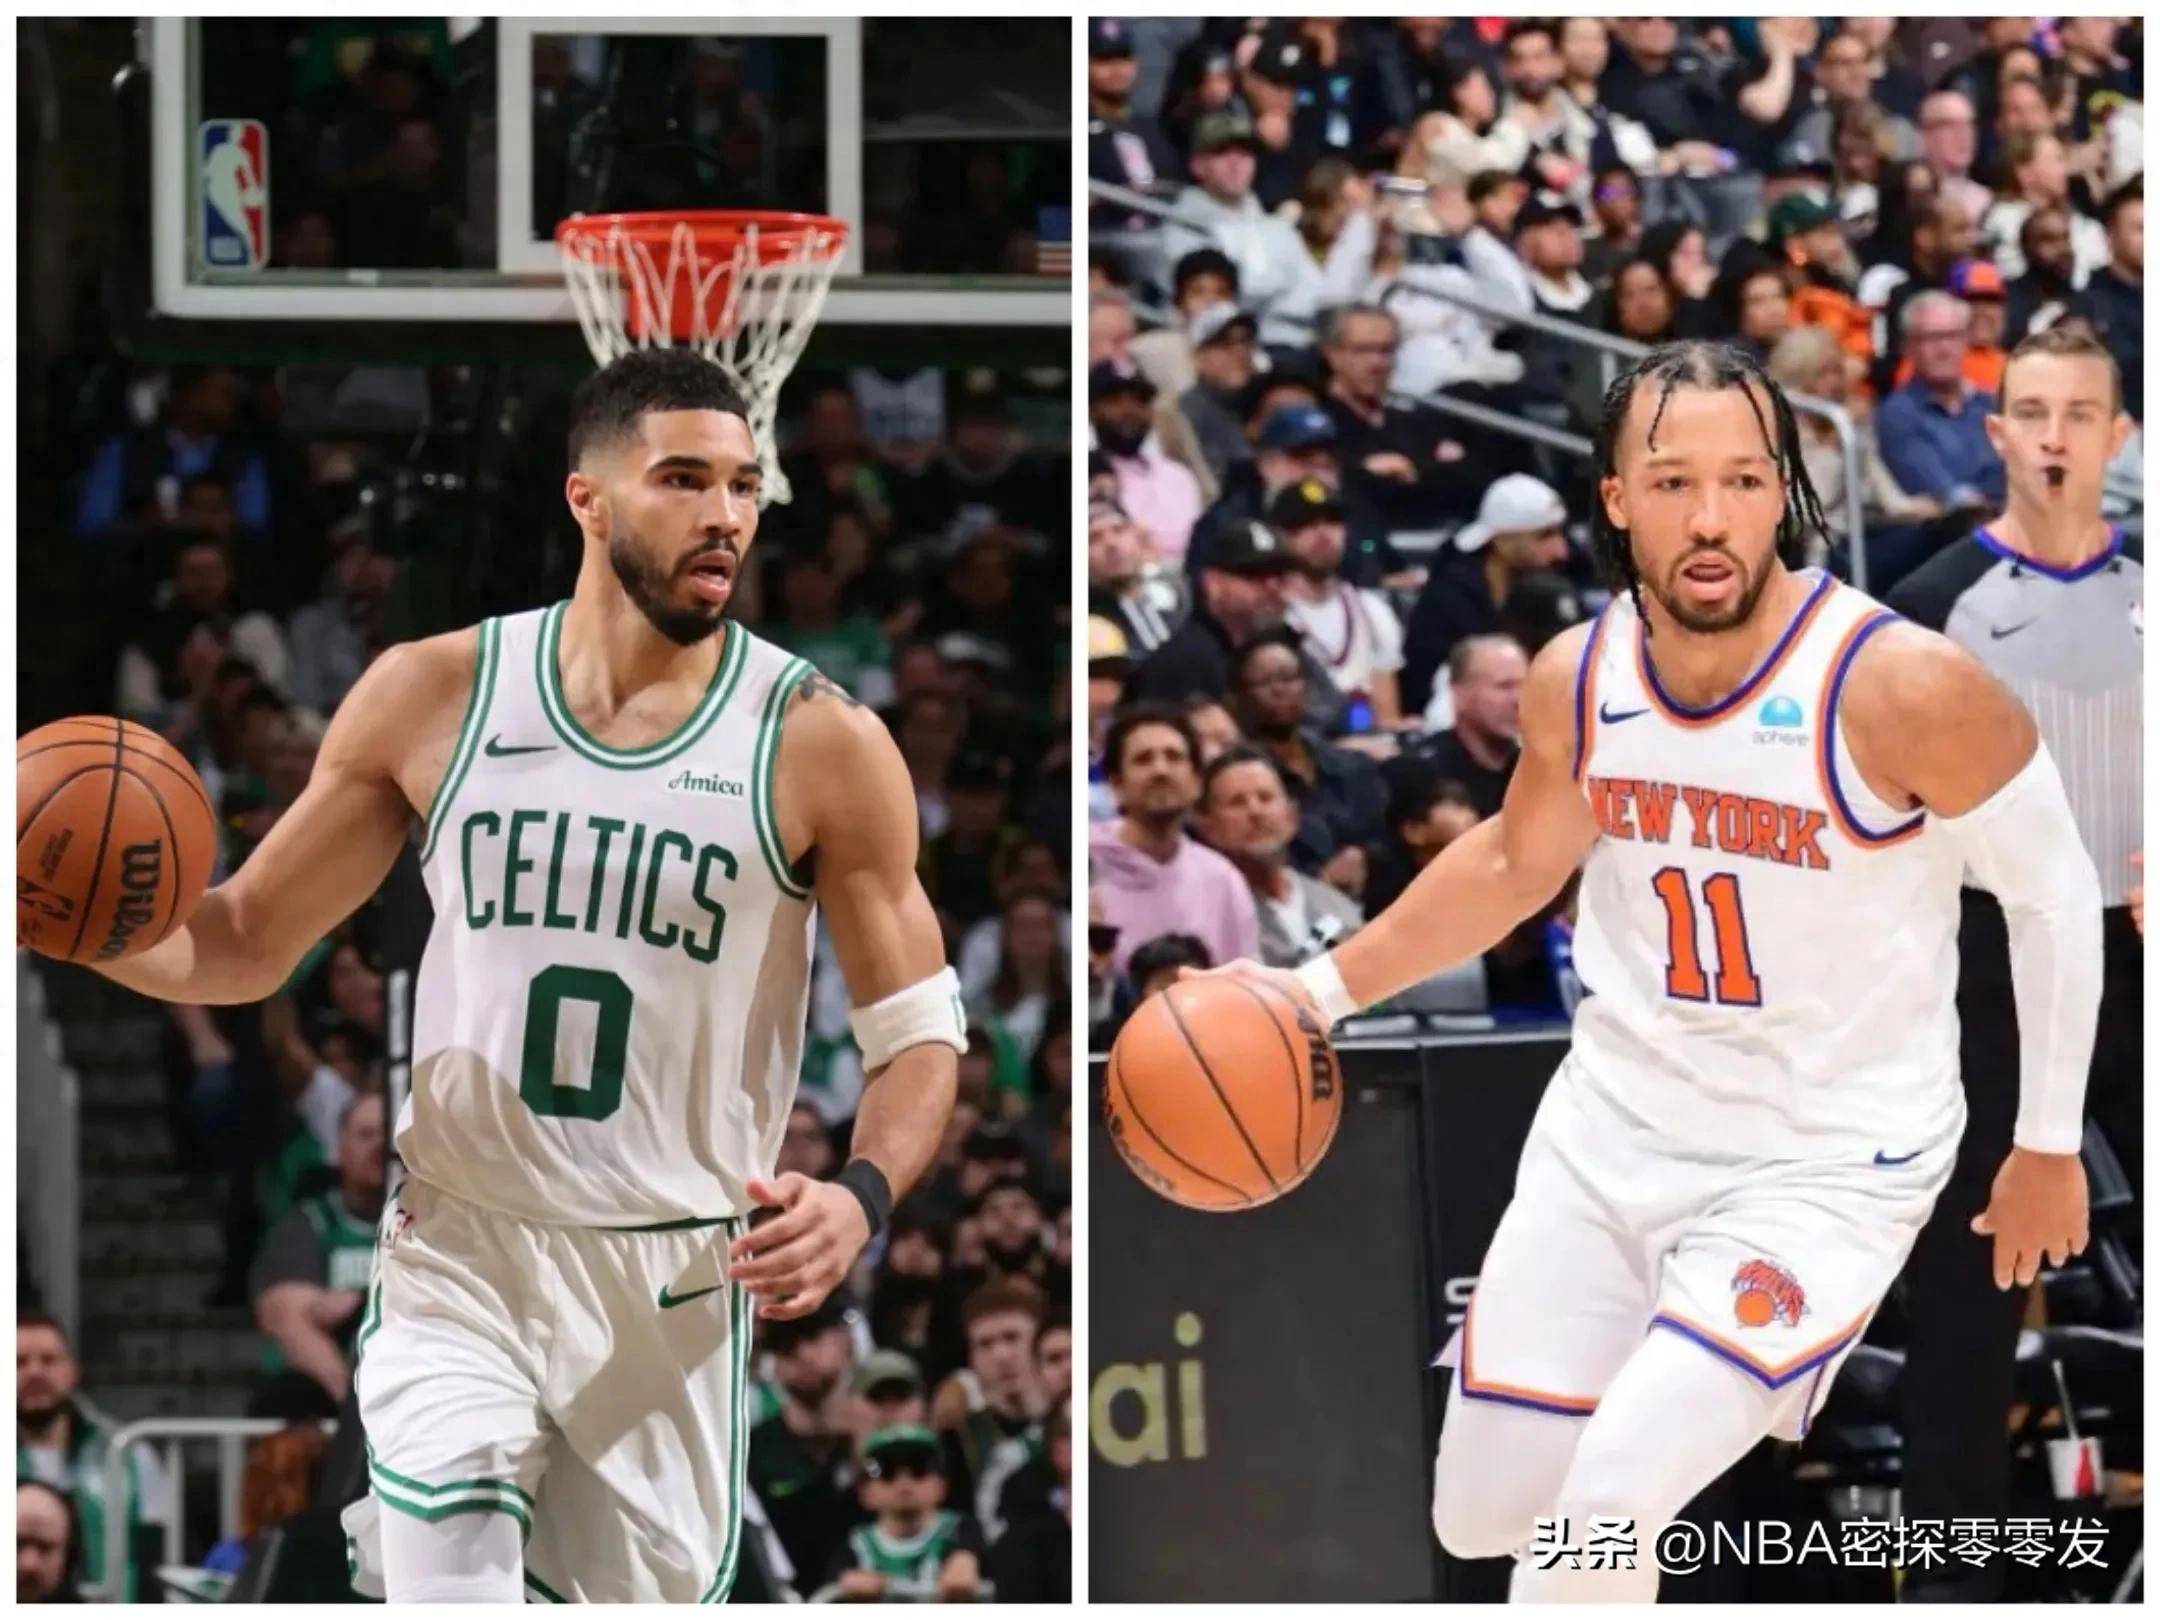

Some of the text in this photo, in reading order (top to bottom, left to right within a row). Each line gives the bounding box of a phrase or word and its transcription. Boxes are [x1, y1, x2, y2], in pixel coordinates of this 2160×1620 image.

[668, 769, 744, 796] Amica
[1680, 785, 1831, 871] YORK
[461, 809, 738, 964] CELTICS
[1651, 865, 1762, 1007] 11
[519, 963, 634, 1122] 0
